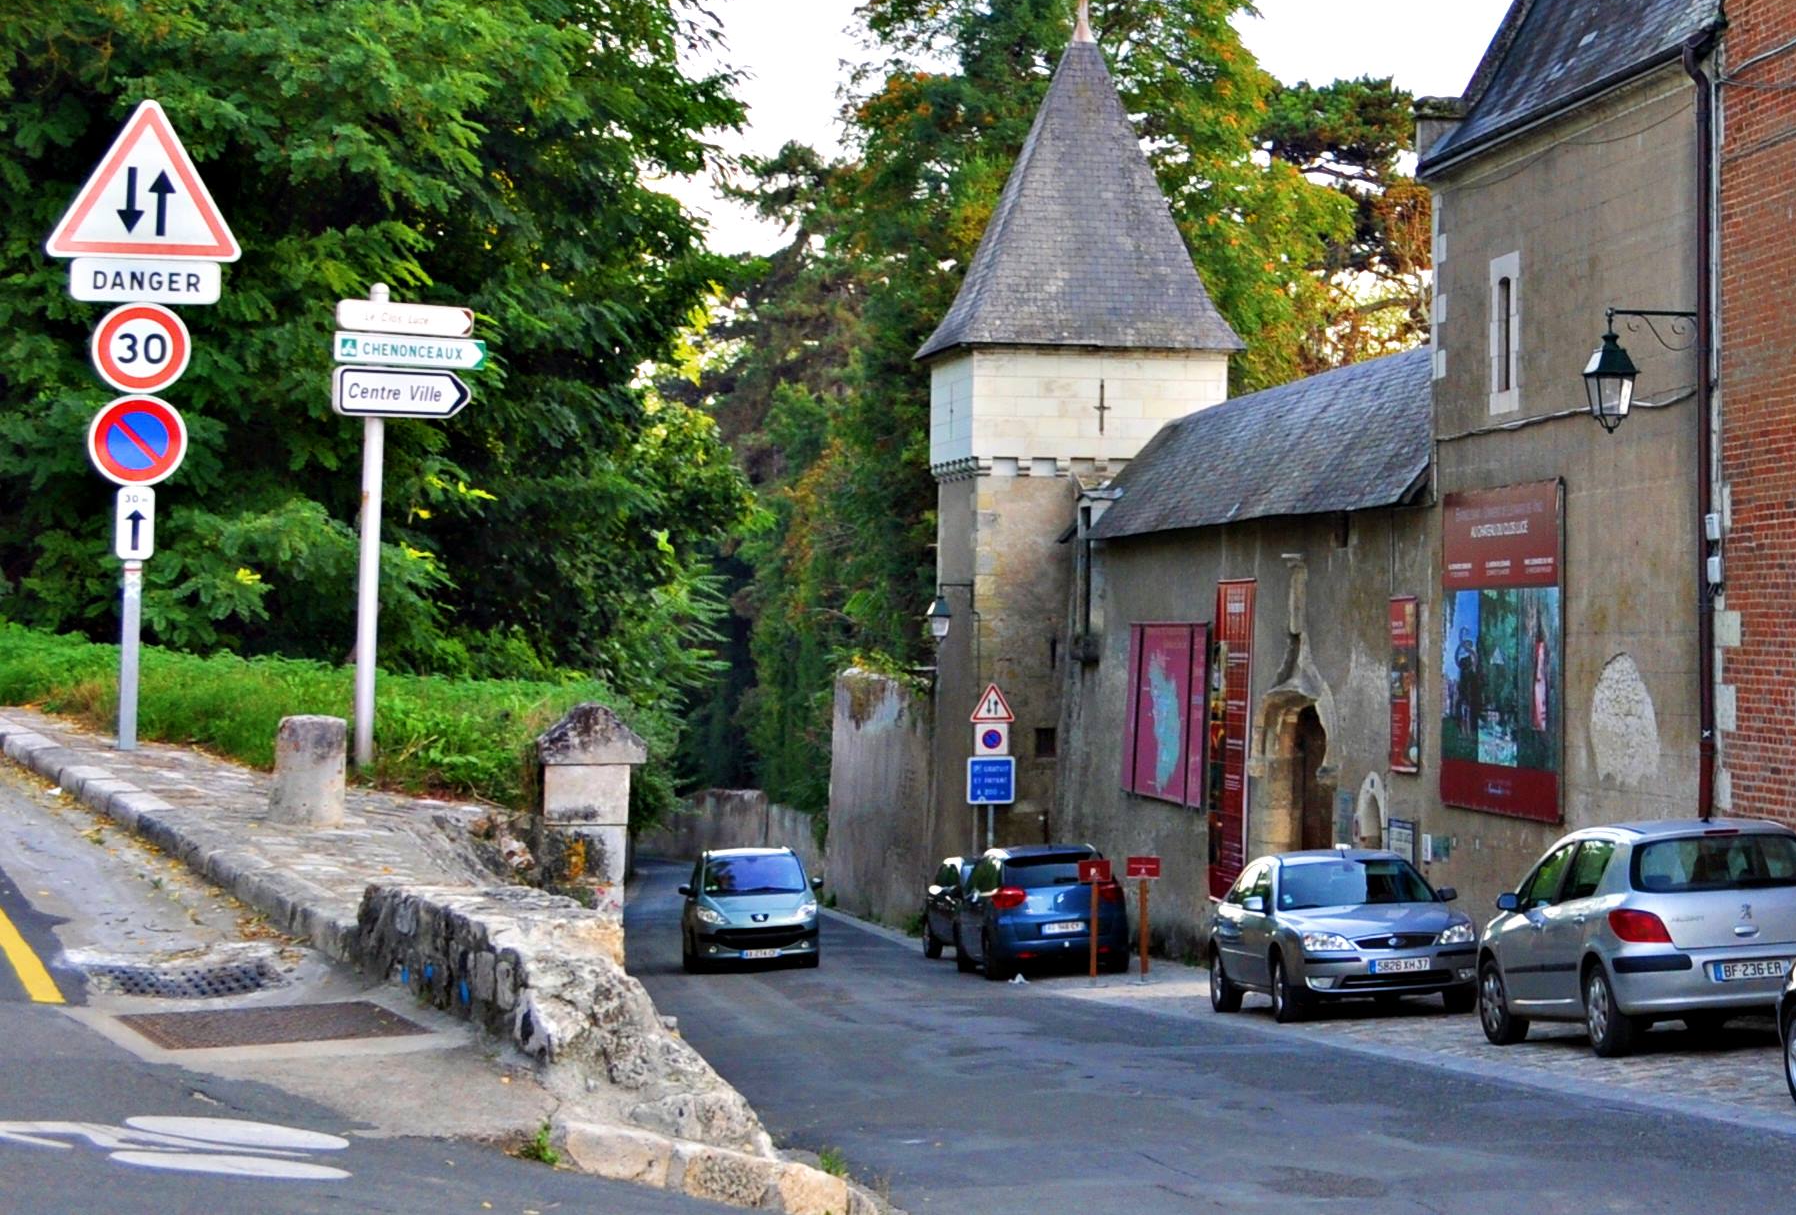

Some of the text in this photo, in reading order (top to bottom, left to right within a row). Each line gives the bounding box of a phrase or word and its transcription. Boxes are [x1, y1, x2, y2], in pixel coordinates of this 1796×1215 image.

[92, 270, 200, 293] DANGER
[117, 333, 167, 365] 30
[362, 341, 463, 361] CHENONCEAUX
[348, 382, 442, 403] Centre Ville
